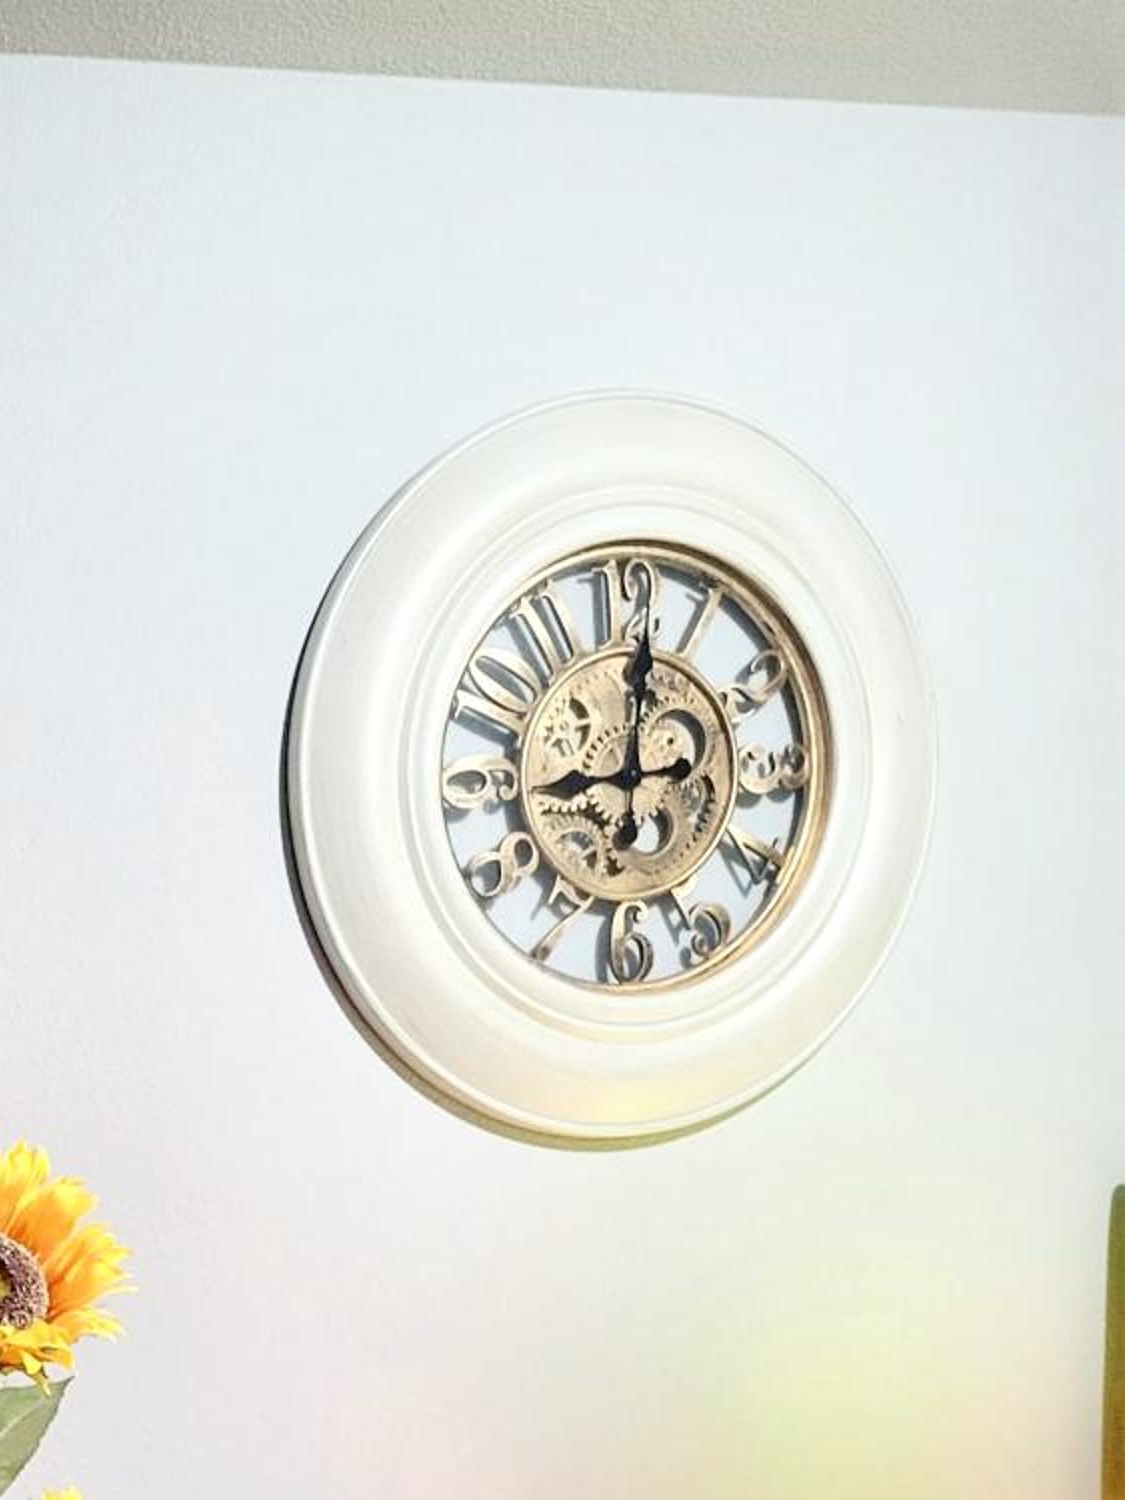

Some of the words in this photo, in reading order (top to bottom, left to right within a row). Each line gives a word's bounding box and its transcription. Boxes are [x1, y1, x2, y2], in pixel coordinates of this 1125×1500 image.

[505, 580, 583, 685] 11
[590, 558, 660, 650] 12
[675, 584, 725, 658] 1
[453, 650, 543, 748] 10
[718, 650, 787, 723] 2
[441, 756, 519, 808] 9
[737, 743, 811, 793] 3
[467, 831, 540, 898] 8
[725, 828, 786, 886] 4
[531, 873, 596, 961] 7
[609, 900, 653, 983] 6
[671, 875, 730, 958] 5
